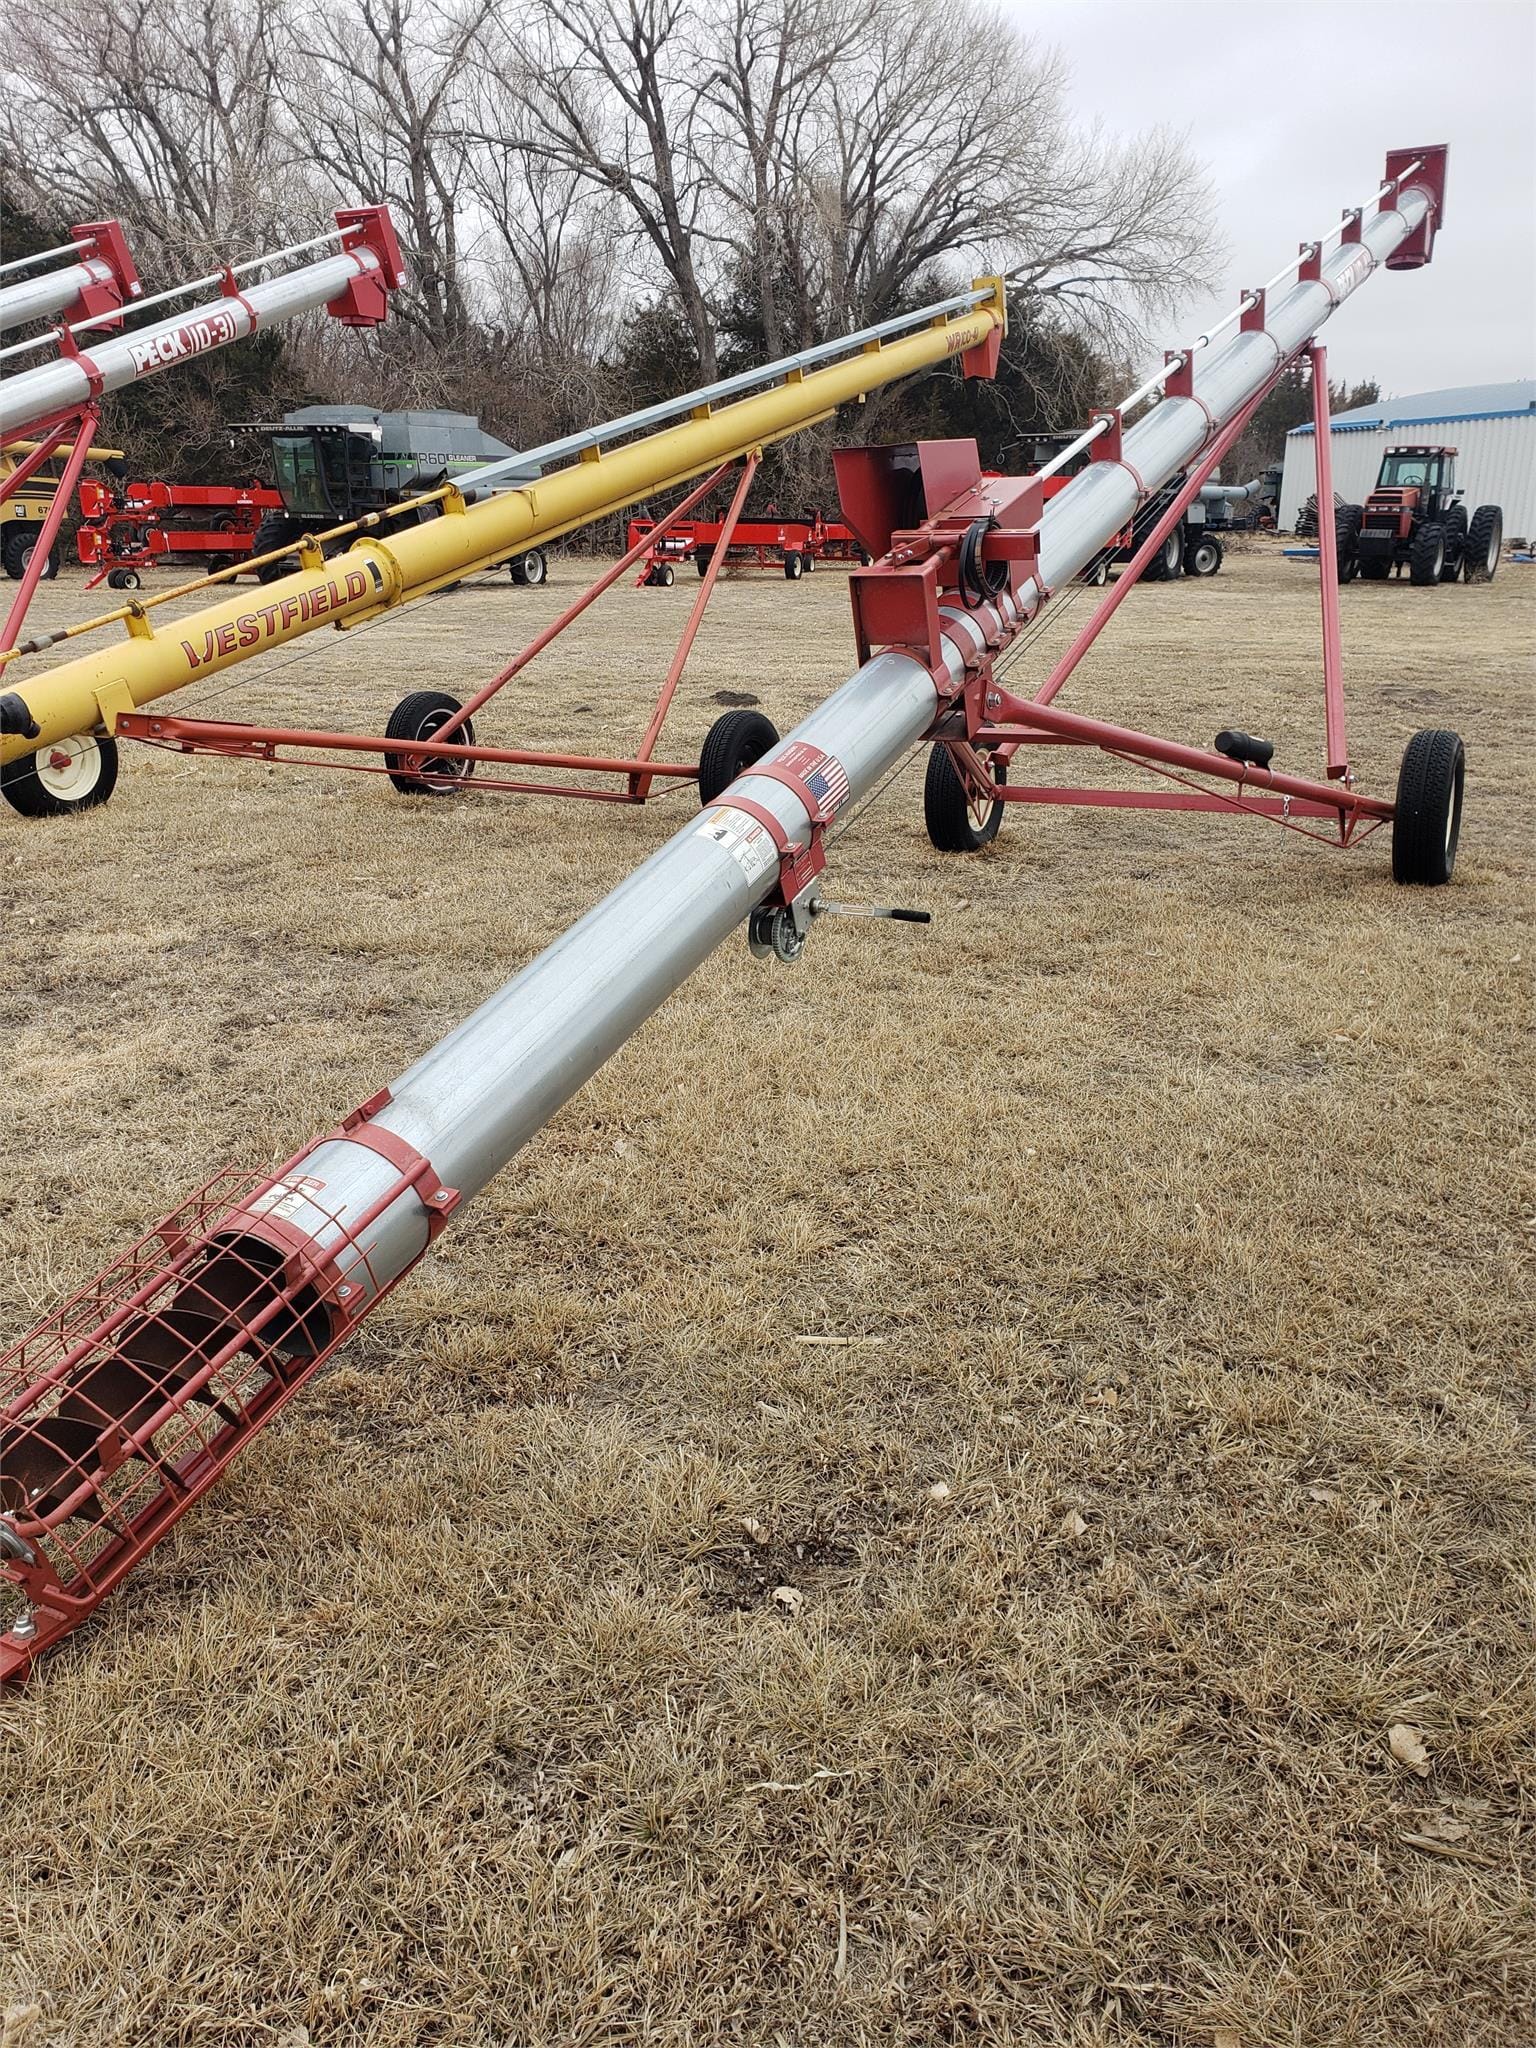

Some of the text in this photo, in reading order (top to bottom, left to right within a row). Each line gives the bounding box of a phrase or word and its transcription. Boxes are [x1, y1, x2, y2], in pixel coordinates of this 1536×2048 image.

[129, 327, 188, 372] PECK
[419, 452, 447, 465] R60
[448, 454, 477, 462] GLEANER
[181, 570, 367, 669] WESTFIELD
